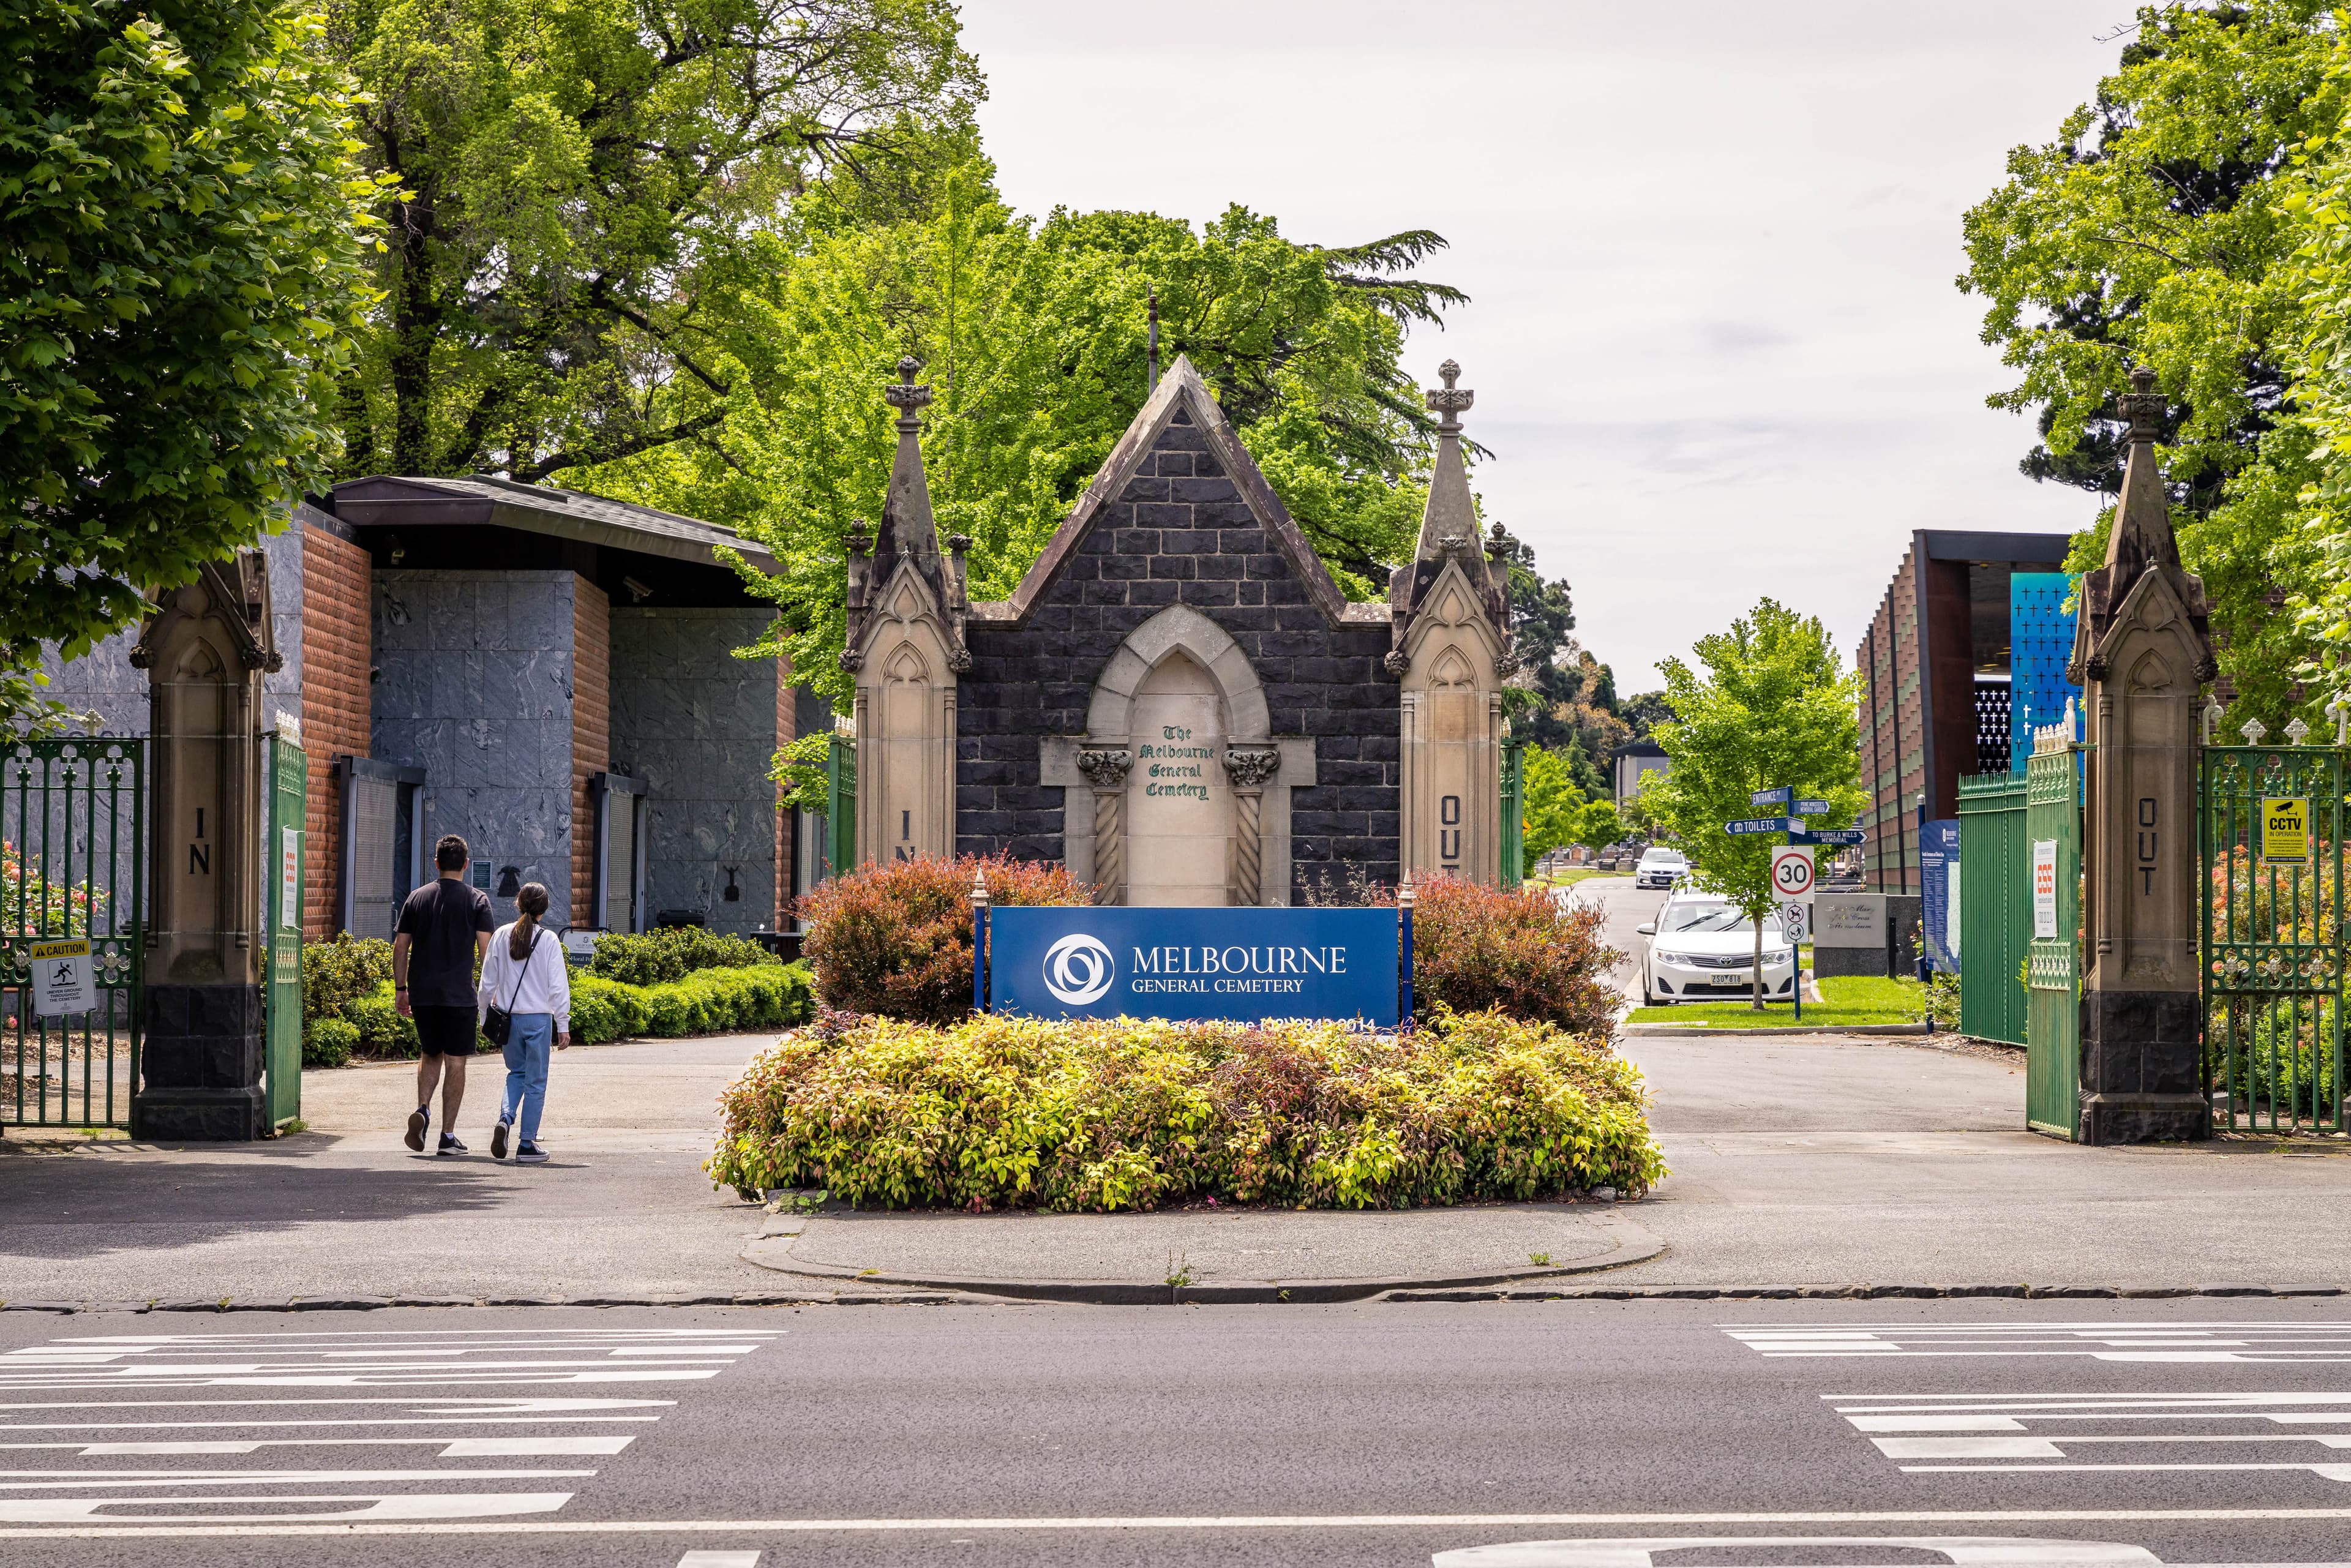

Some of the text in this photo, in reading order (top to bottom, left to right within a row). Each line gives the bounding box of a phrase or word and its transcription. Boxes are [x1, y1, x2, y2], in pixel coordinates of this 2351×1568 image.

[1163, 725, 1191, 741] The
[1139, 744, 1215, 759] Melbourne
[1149, 763, 1202, 777] General
[1146, 782, 1209, 800] Cemetery
[1753, 790, 1776, 805] ENTRANCE
[1744, 820, 1775, 832] TOILETS
[2270, 817, 2301, 830] CCTV
[2138, 798, 2158, 896] OUT
[1780, 865, 1807, 883] 30
[47, 943, 85, 956] CAUTION
[1132, 947, 1346, 973] MELBOURNE
[1132, 979, 1304, 993] GENERAL CEMETERY
